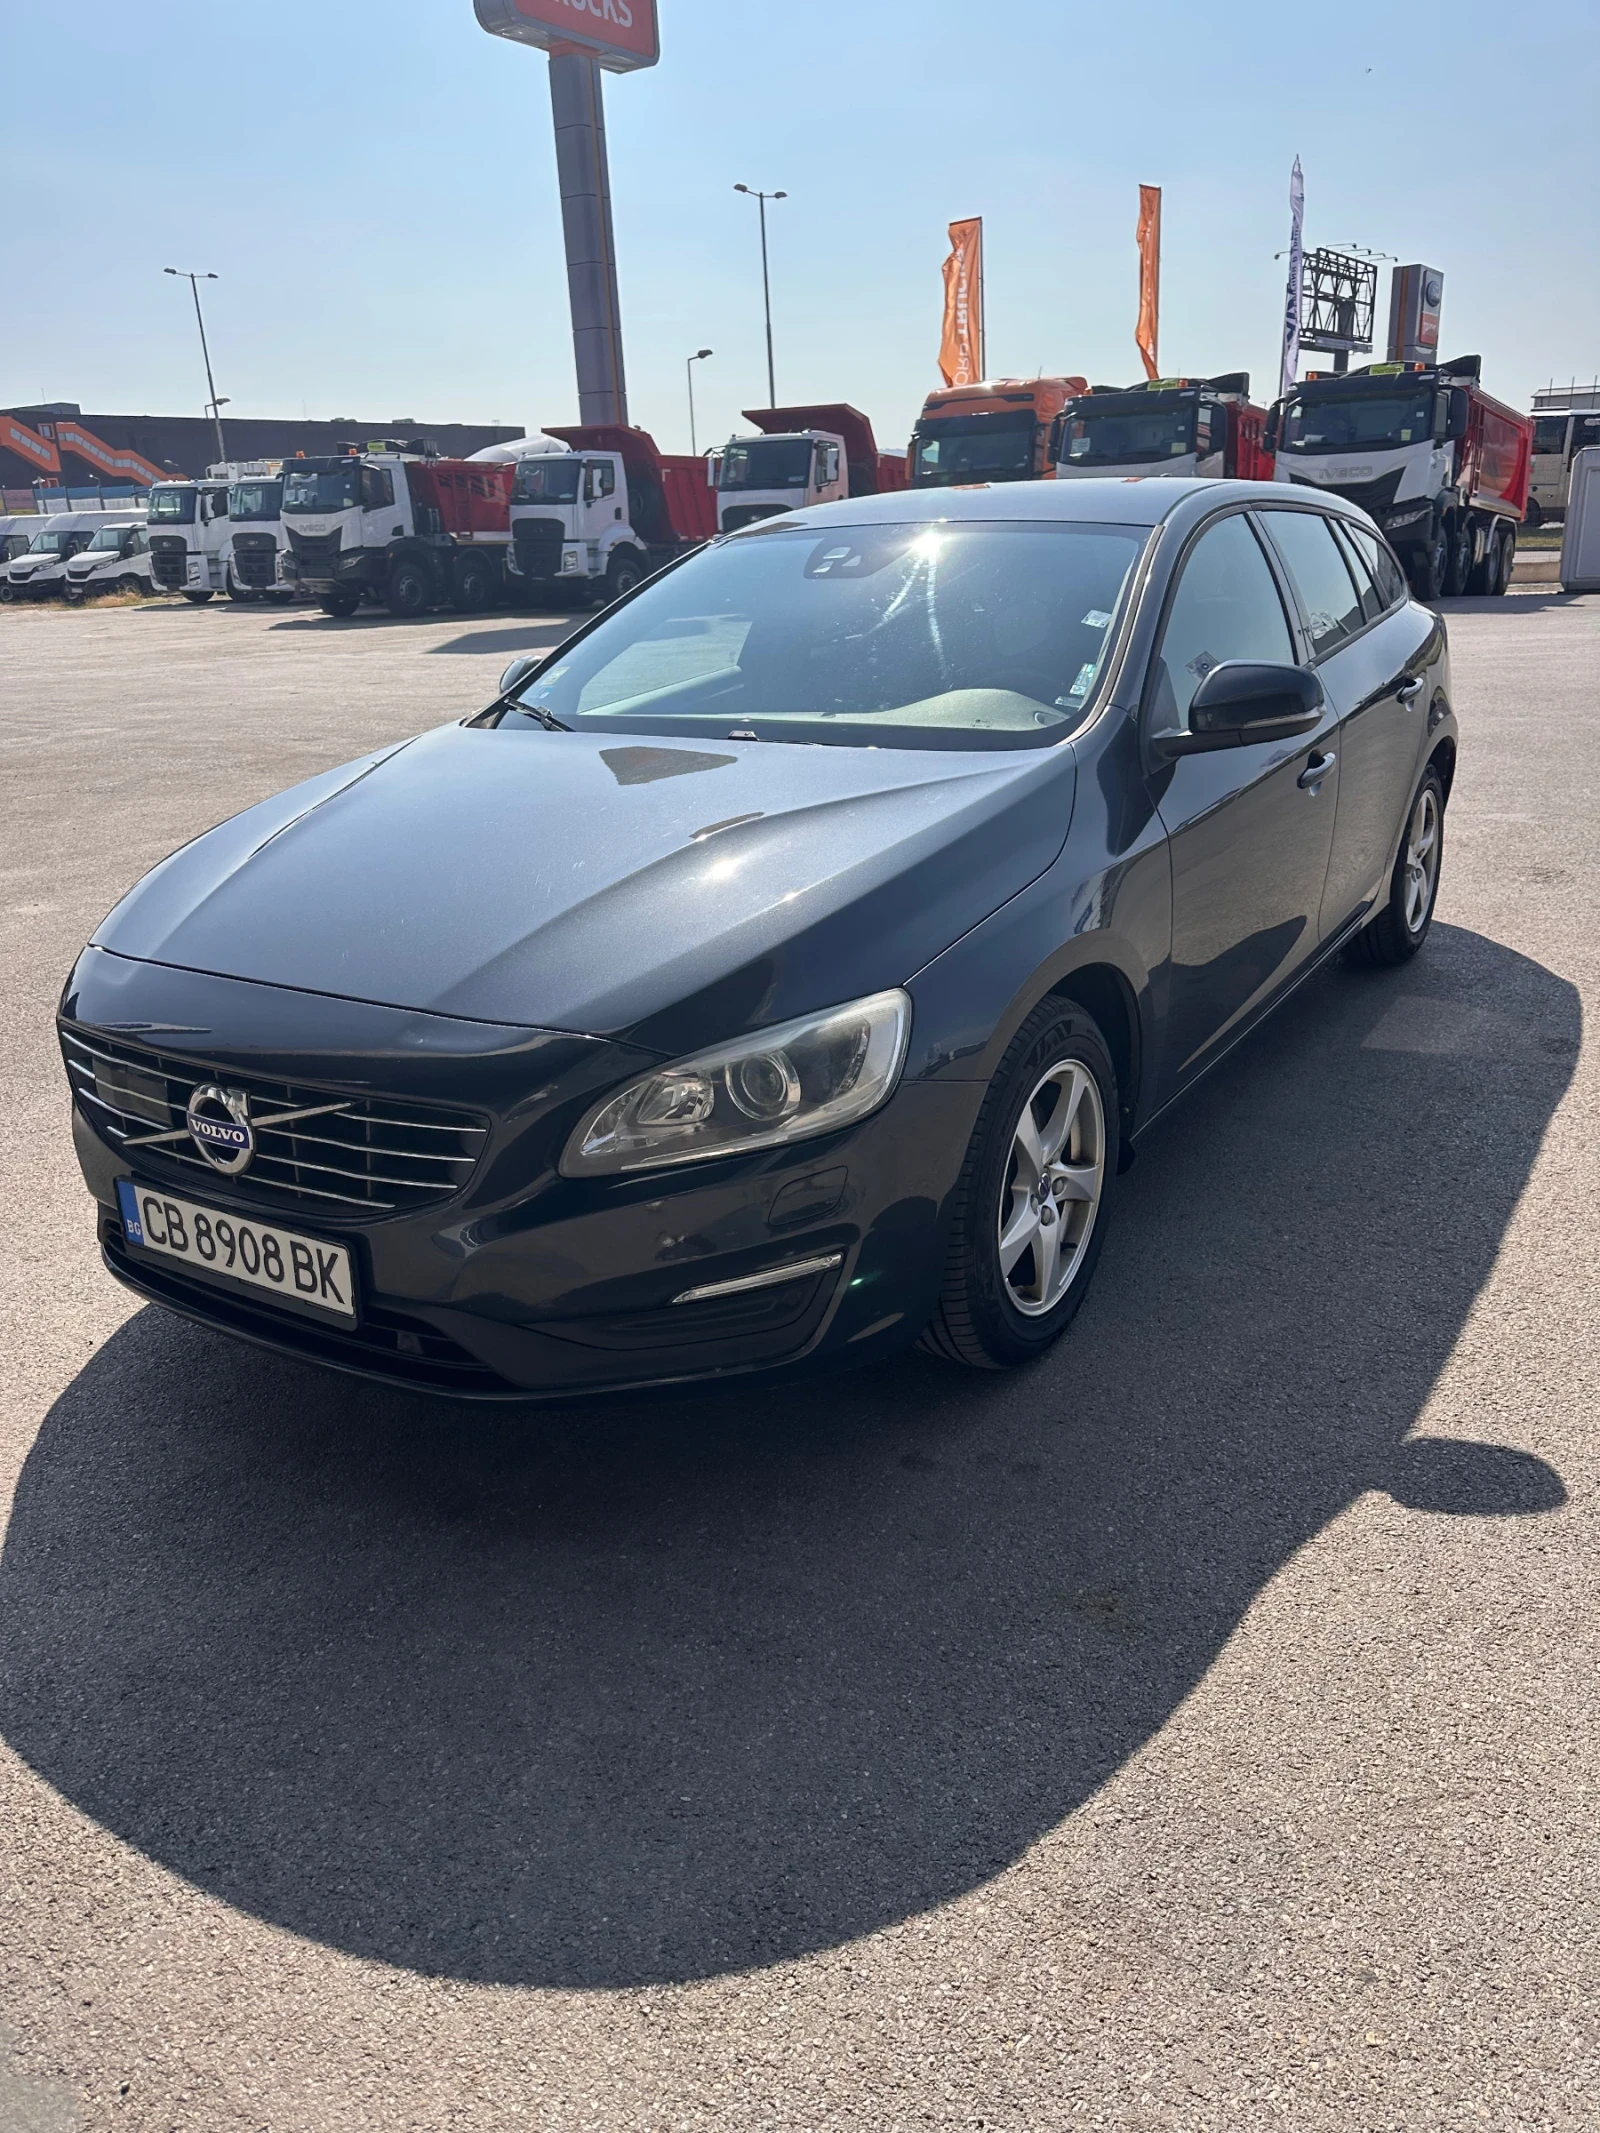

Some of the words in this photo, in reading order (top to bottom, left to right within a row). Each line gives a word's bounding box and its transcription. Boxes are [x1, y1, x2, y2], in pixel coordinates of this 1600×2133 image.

[1318, 465, 1373, 479] IVECO
[190, 1118, 245, 1143] VOLVO
[126, 1219, 142, 1236] BG
[142, 1196, 189, 1252] CB
[194, 1213, 285, 1283] 8908
[290, 1240, 346, 1305] BK
